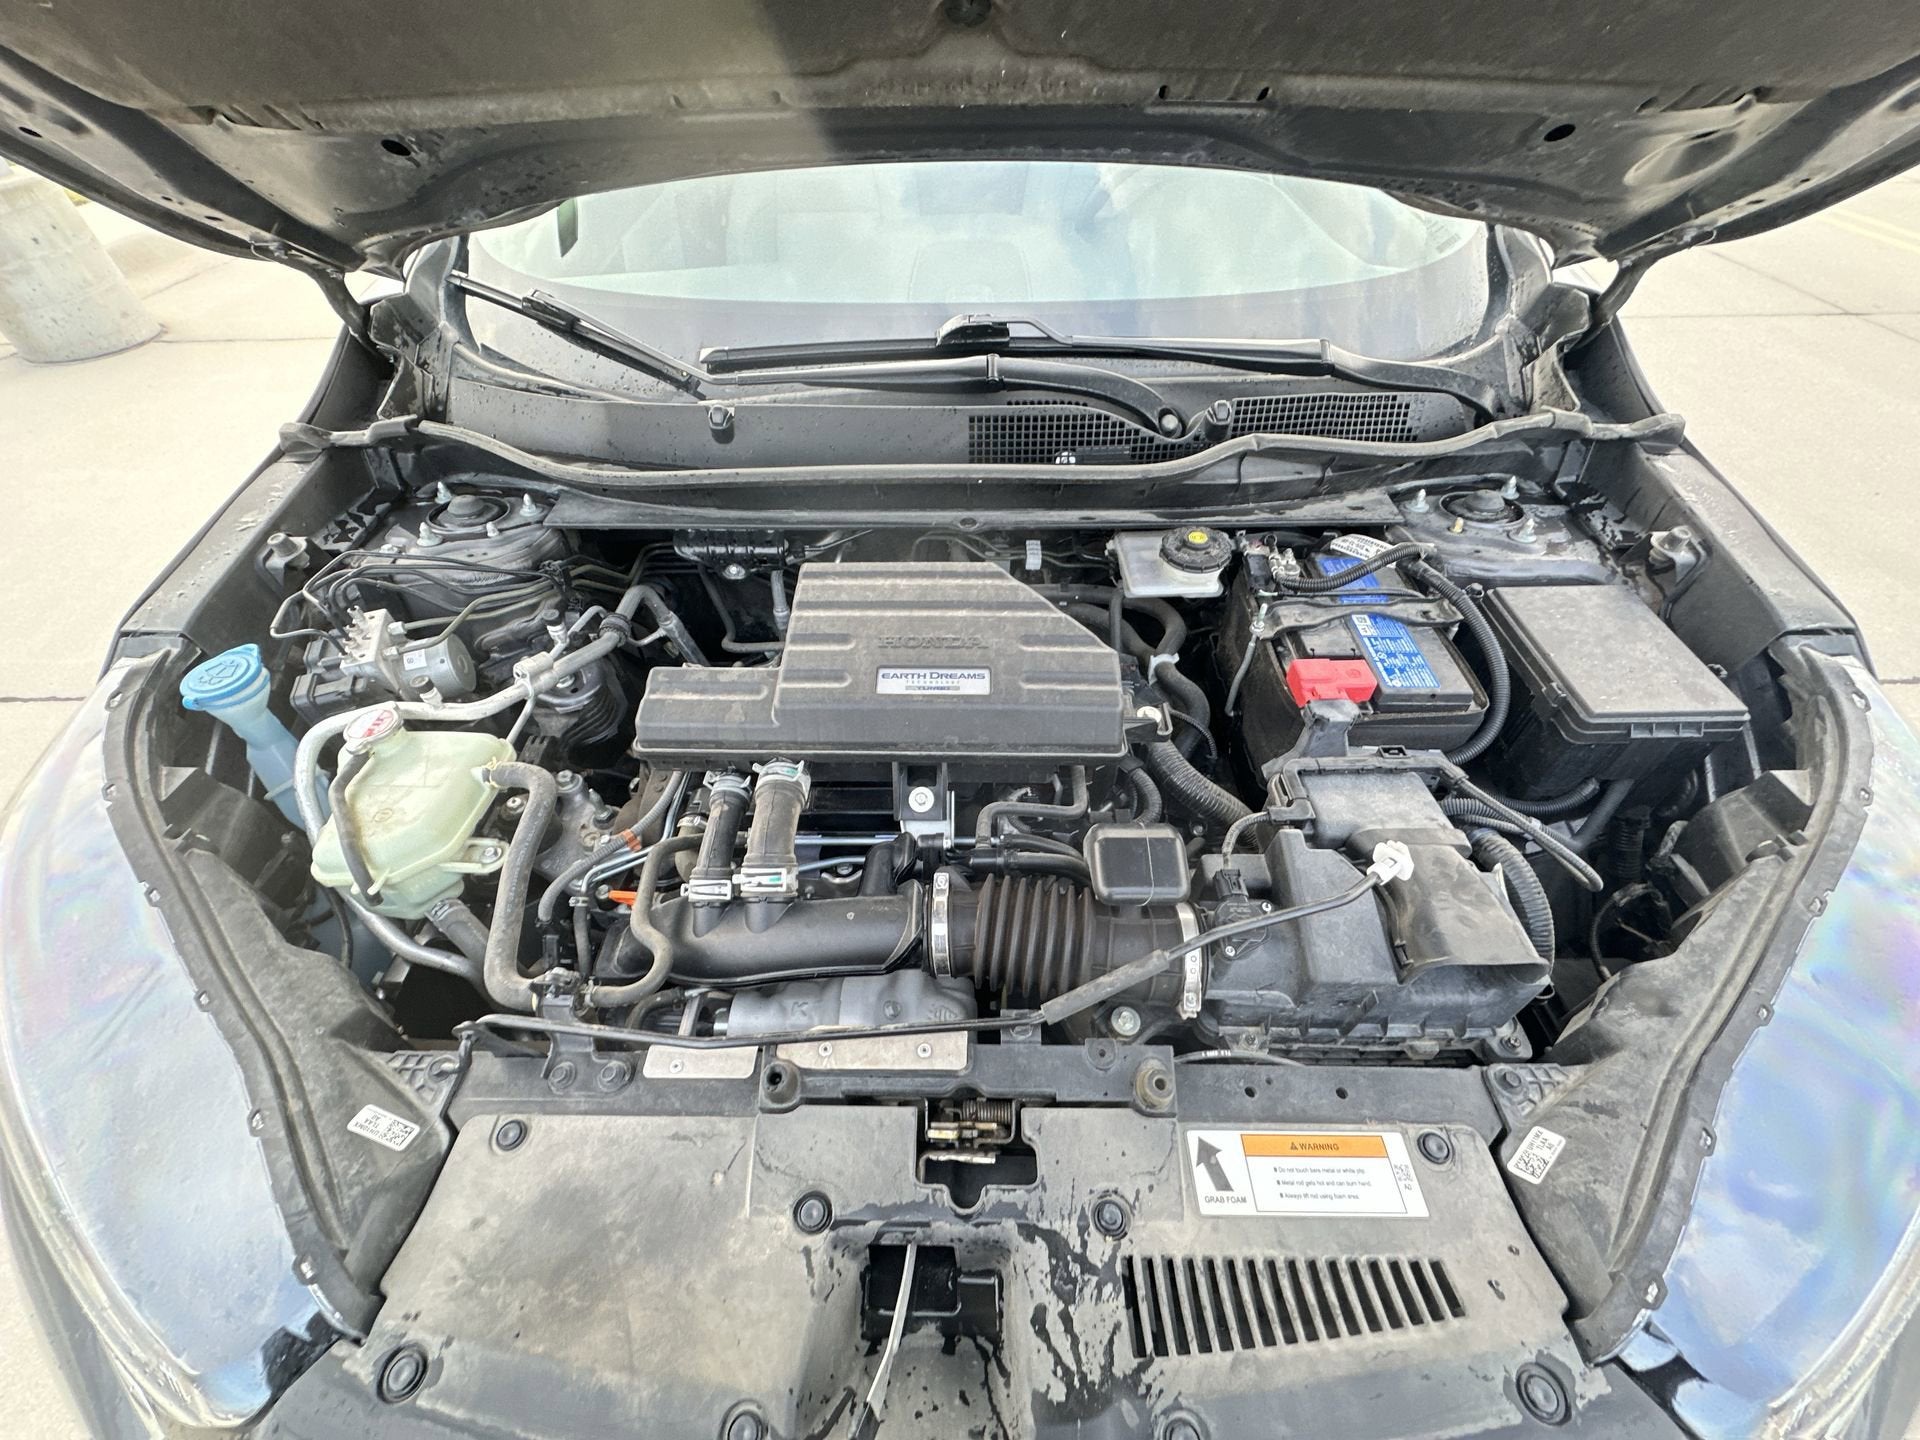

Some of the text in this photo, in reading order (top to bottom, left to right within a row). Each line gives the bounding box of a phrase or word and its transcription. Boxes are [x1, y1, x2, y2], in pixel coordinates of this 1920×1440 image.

[878, 635, 990, 649] HONDA
[881, 671, 986, 680] EARTH DREAMS
[1299, 1143, 1340, 1151] WARNING
[1204, 1195, 1248, 1203] GRAB FOAM
[1285, 1192, 1302, 1200] Always
